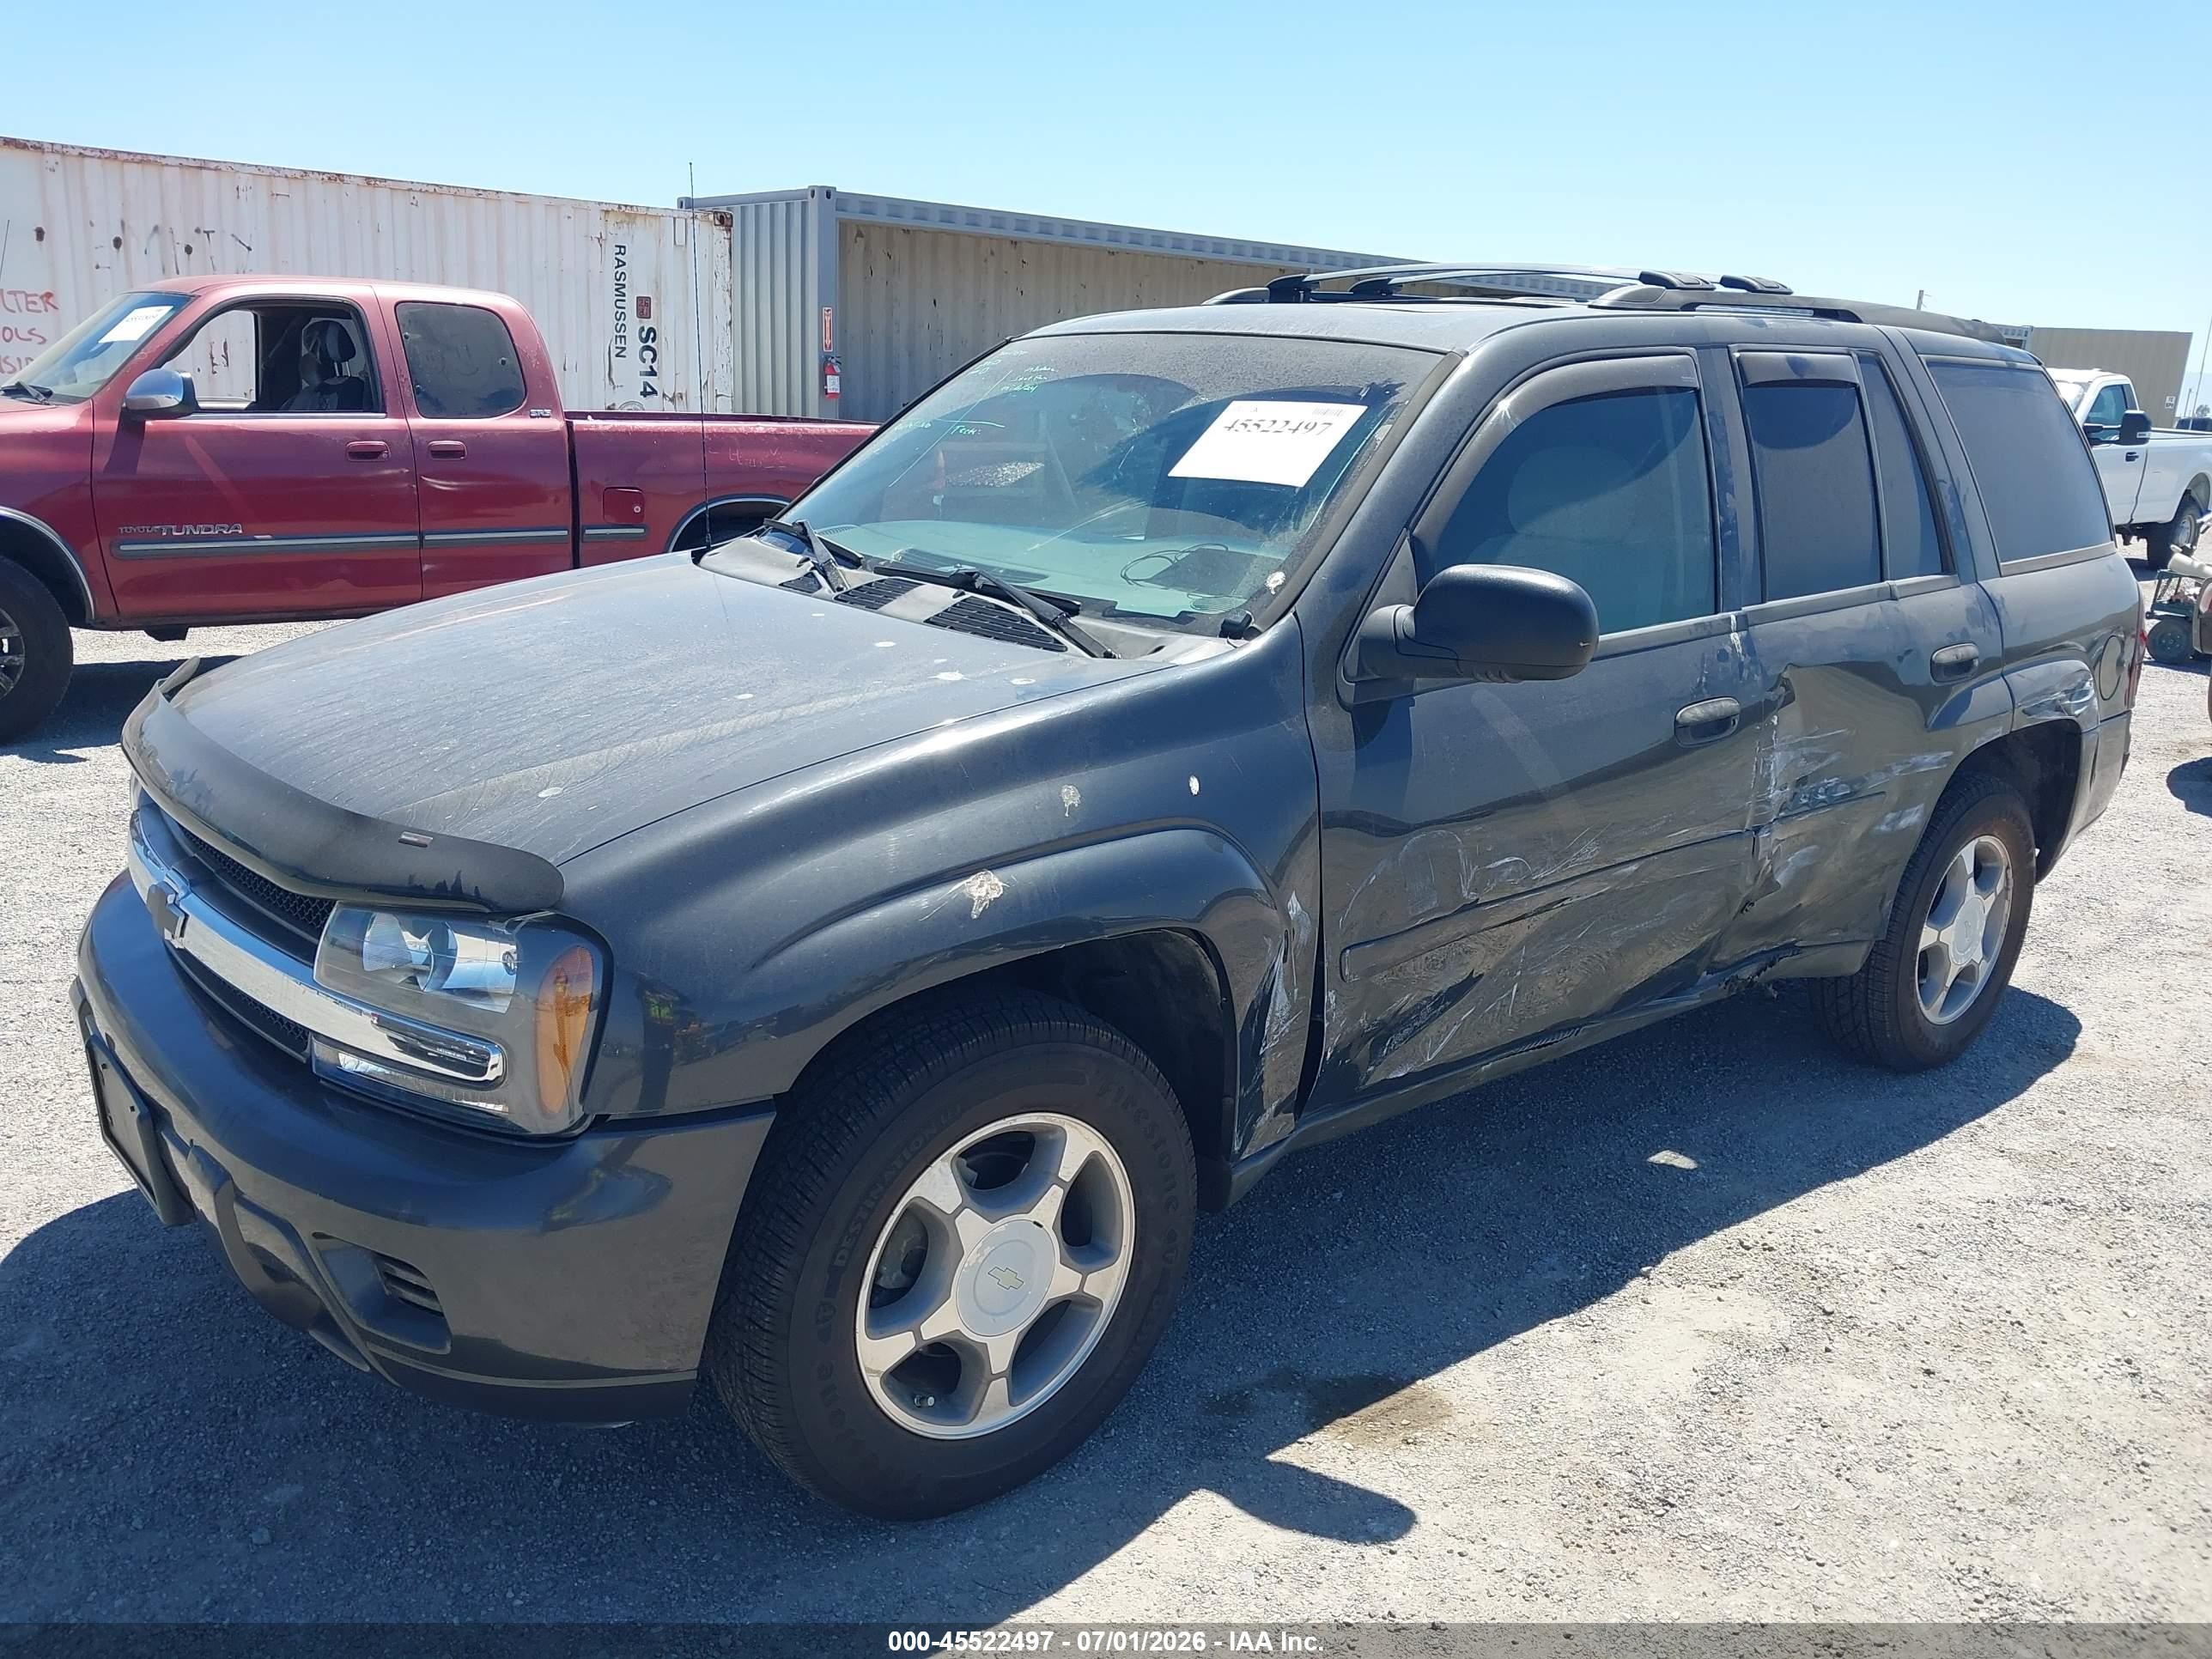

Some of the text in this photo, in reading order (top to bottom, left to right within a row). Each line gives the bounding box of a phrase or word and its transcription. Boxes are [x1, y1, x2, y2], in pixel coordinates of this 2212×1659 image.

[614, 244, 627, 358] RASMUSSEN
[638, 325, 659, 398] SC14
[1224, 418, 1334, 435] 45522497
[156, 523, 243, 536] TUNDRA
